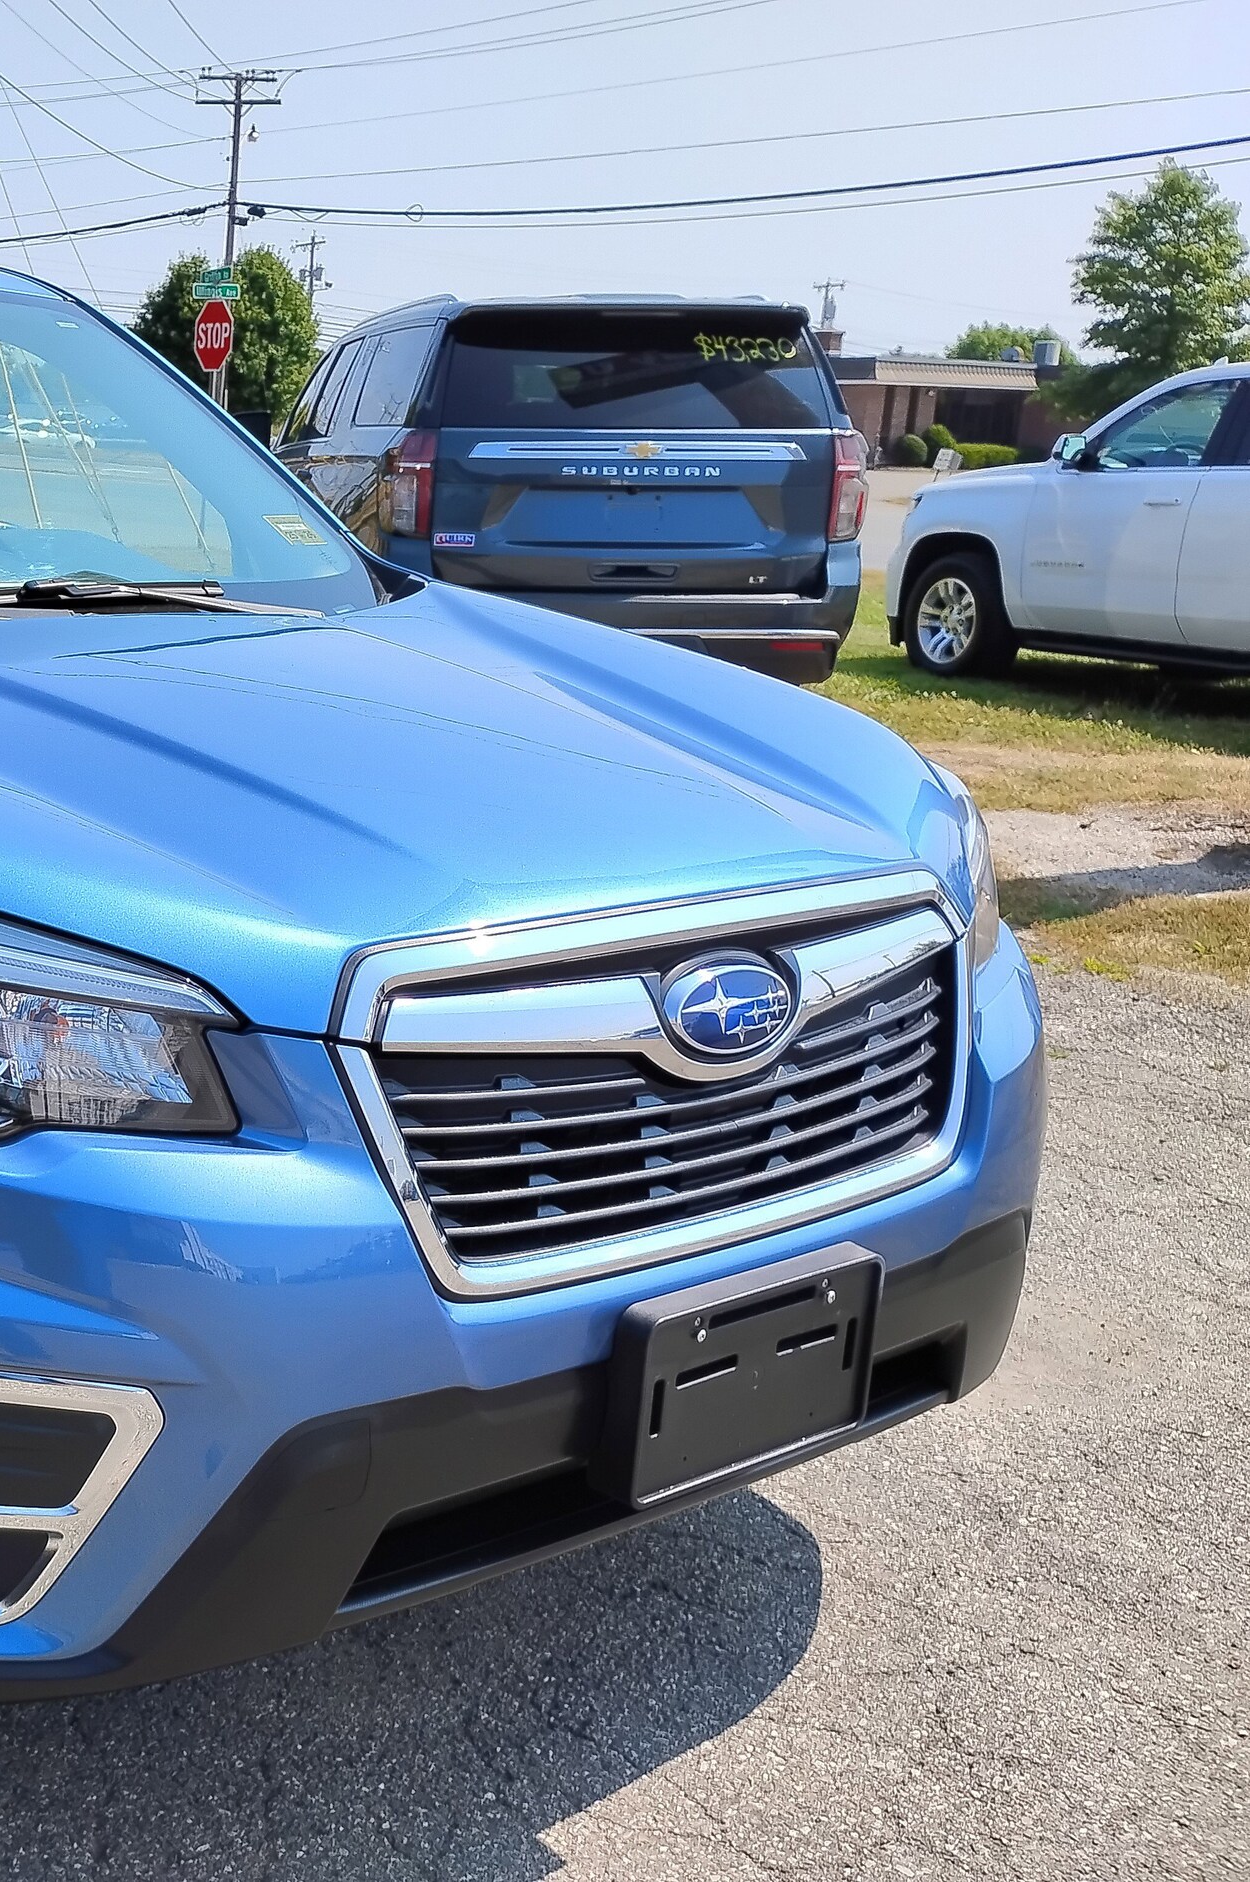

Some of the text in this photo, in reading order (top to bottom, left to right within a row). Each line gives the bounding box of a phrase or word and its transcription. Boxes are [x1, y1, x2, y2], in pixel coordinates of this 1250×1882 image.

[197, 322, 230, 349] STOP
[561, 466, 721, 477] SUBURBAN
[748, 575, 768, 584] LT
